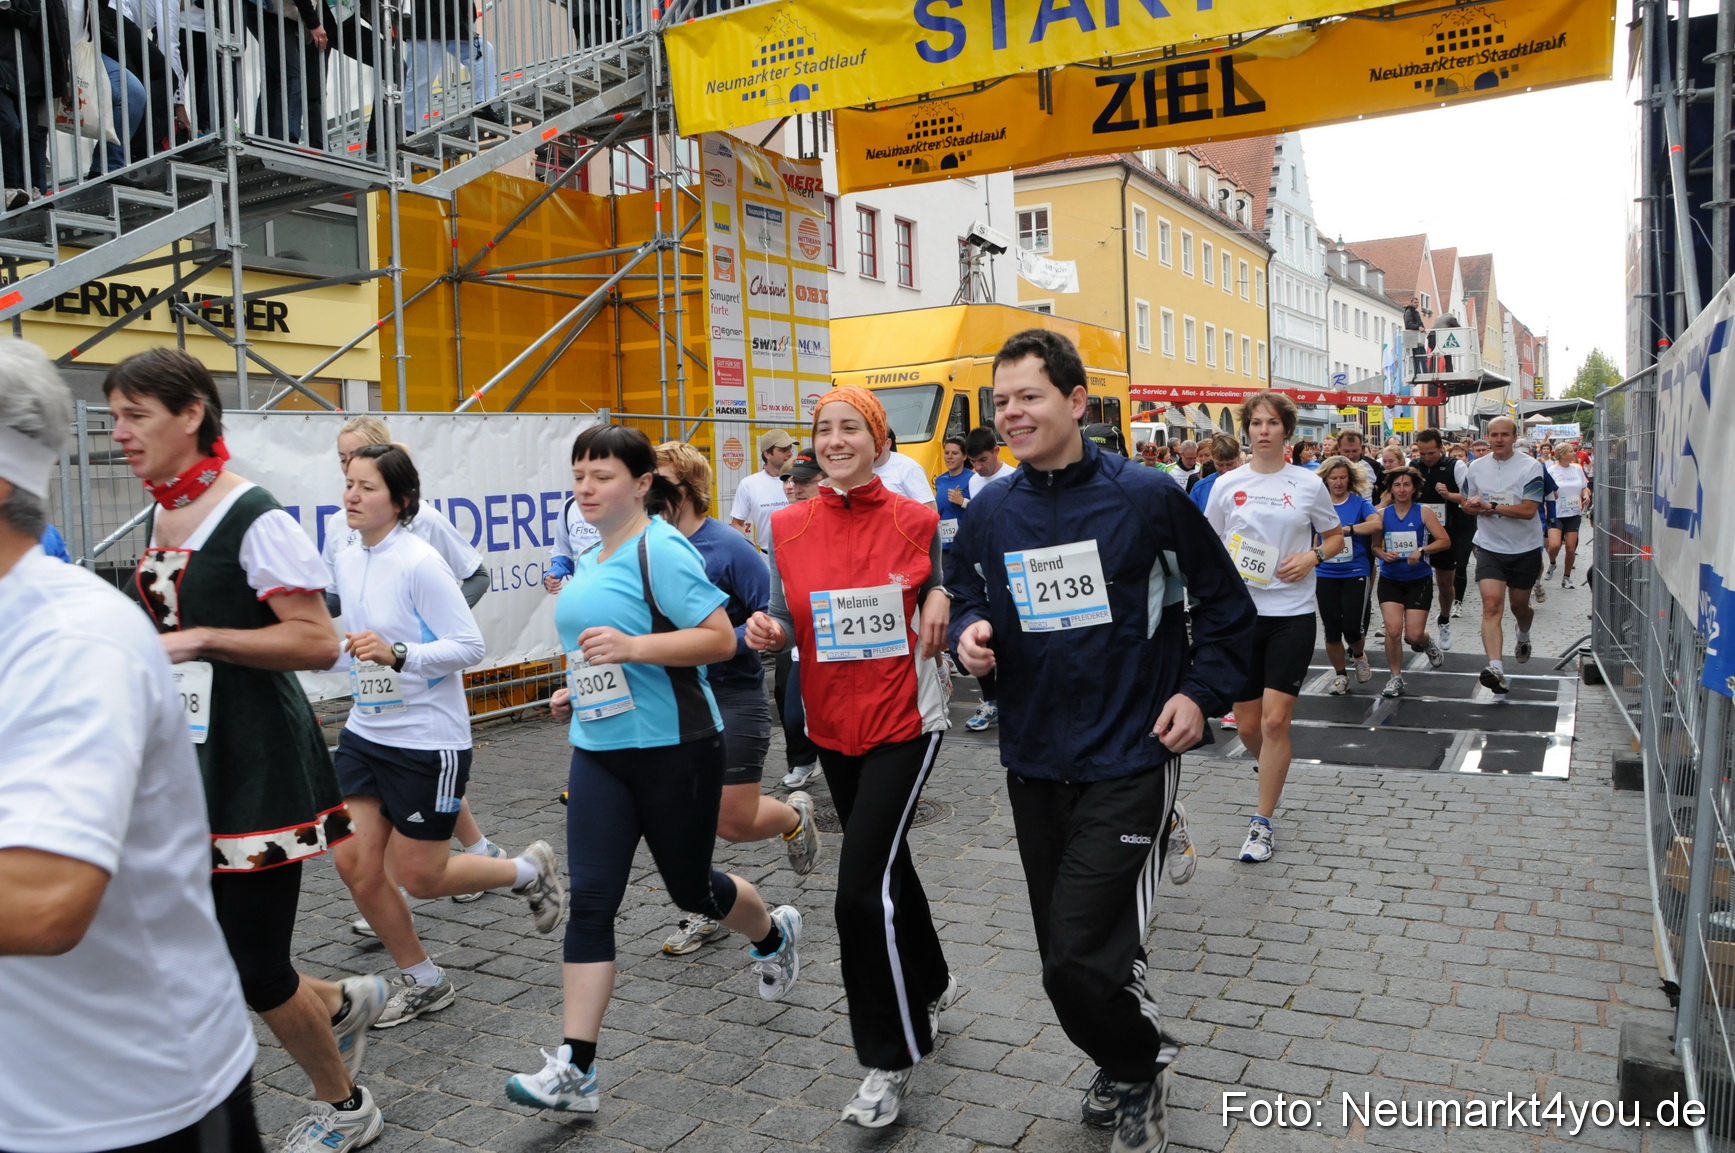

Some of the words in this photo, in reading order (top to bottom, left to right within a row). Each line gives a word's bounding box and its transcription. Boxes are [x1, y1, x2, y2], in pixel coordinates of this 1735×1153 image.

[1369, 55, 1474, 82] Neumarkter
[1480, 32, 1567, 63] Stadtlauf
[706, 66, 790, 94] Neumarkter
[793, 49, 867, 75] Stadtlauf
[1093, 55, 1266, 134] ZIEL
[866, 140, 941, 160] Neumarkter
[945, 127, 1007, 148] Stadtlauf
[782, 173, 824, 192] MERZ
[710, 288, 740, 304] Sinupret
[795, 284, 828, 305] OBI
[711, 303, 729, 316] forte
[721, 327, 743, 336] Egner
[797, 339, 821, 354] MCM
[865, 371, 920, 385] TIMING
[1090, 376, 1106, 386] SERVICE
[716, 407, 747, 415] HACKNER
[1537, 426, 1577, 437] APLAUS
[1241, 541, 1266, 557] Simone
[1030, 555, 1064, 573] Bernd
[1241, 556, 1266, 574] 556
[1036, 574, 1094, 603] 2138
[837, 595, 879, 609] Melanie
[841, 613, 896, 635] 2139
[361, 678, 394, 695] 2732
[576, 671, 617, 696] 3302
[1120, 834, 1151, 844] adidas
